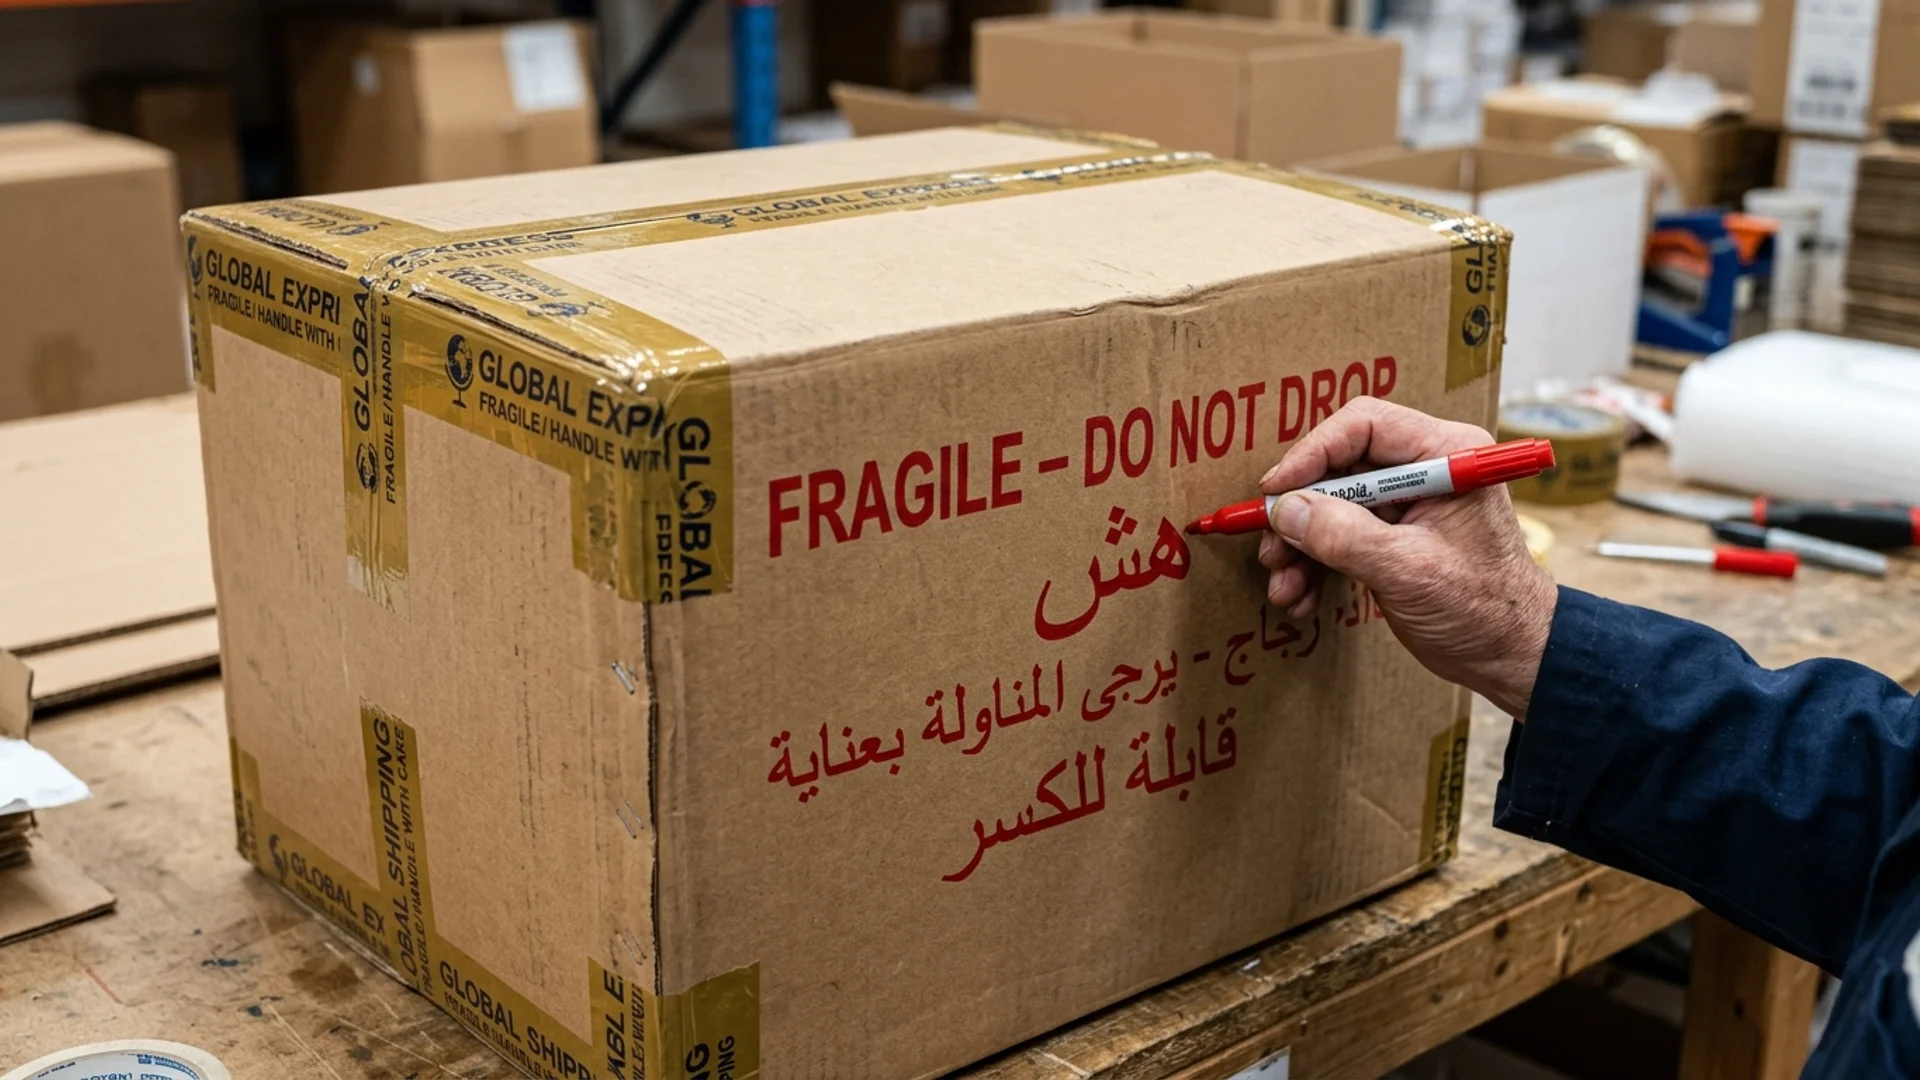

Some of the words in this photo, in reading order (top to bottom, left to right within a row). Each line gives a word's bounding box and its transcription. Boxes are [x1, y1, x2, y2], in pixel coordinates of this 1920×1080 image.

[732, 194, 853, 216] GLOBAL
[205, 250, 275, 301] GLOBAL
[478, 349, 577, 417] GLOBAL
[550, 421, 615, 465] HANDLE
[769, 432, 1023, 558] FRAGILE
[1084, 406, 1154, 488] DO
[1170, 381, 1266, 468] NOT
[1277, 356, 1398, 449] DROP
[1034, 506, 1191, 641] هش
[921, 658, 1065, 756] المناولة
[1081, 650, 1178, 722] يرجى
[767, 720, 905, 803] بعناية
[1125, 706, 1238, 802] قابلة
[373, 717, 406, 888] SHIPPING
[400, 784, 413, 835] WITH
[941, 744, 1106, 883] للكسر
[290, 851, 358, 919] GLOBAL
[439, 960, 522, 1043] GLOBAL
